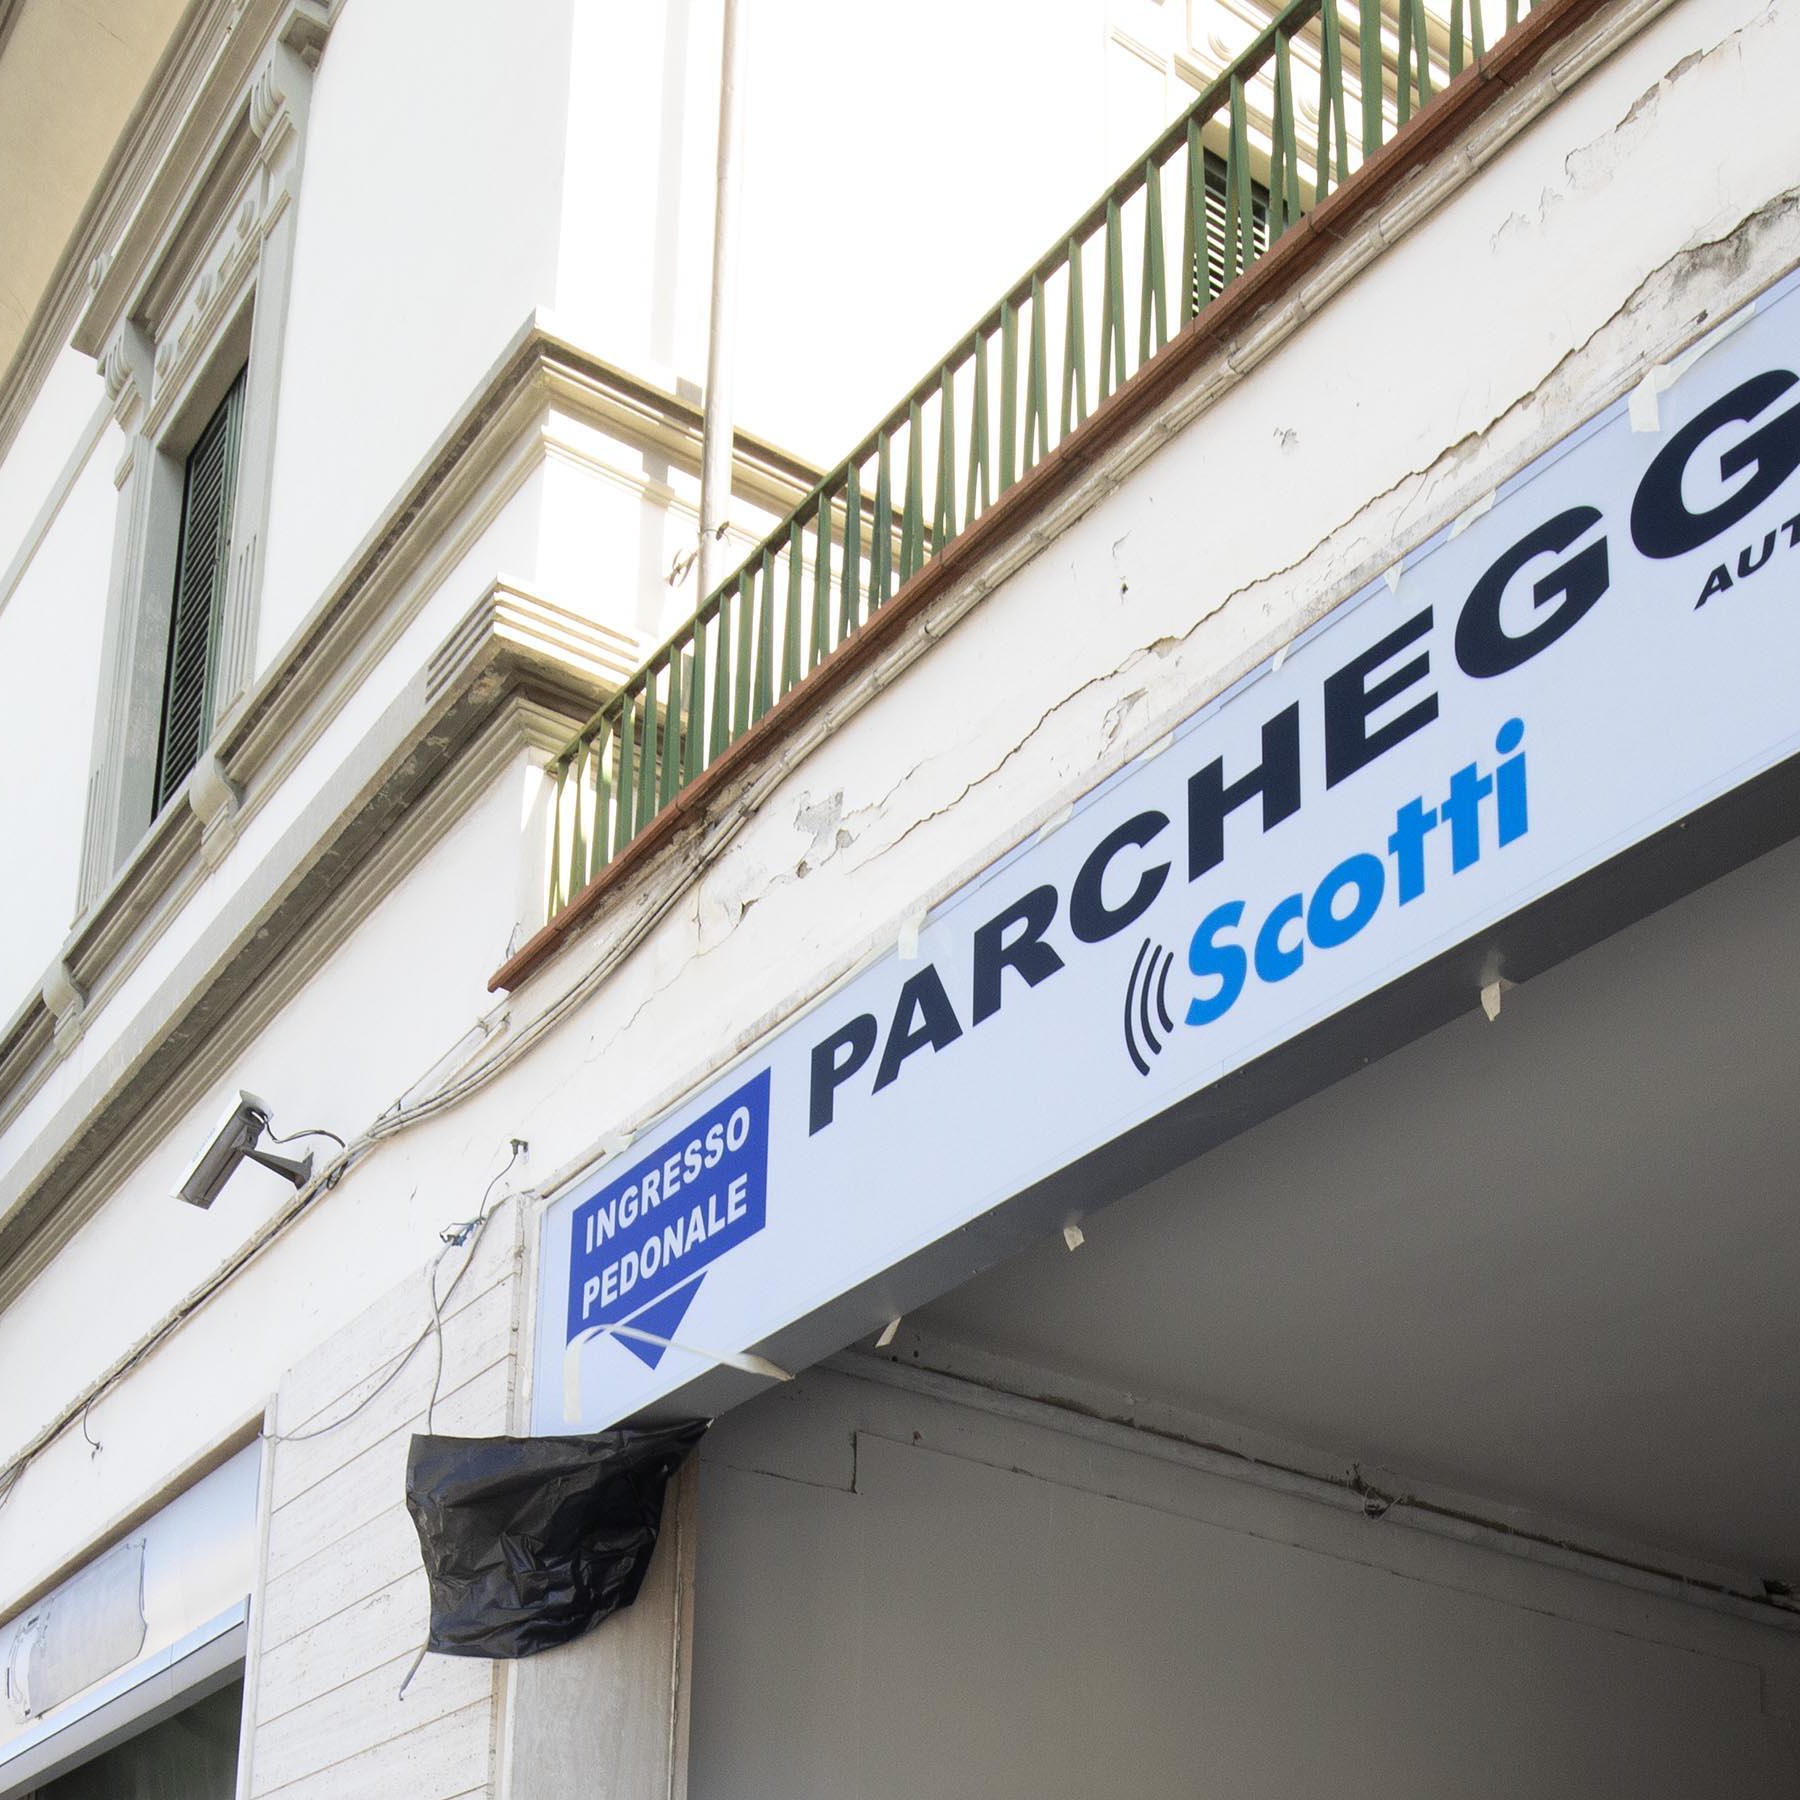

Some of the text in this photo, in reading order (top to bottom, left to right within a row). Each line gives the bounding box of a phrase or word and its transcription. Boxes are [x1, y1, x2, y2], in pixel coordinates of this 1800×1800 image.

[1185, 717, 1529, 1027] Scotti
[582, 1173, 748, 1321] PEDONALE
[585, 1105, 751, 1256] INGRESSO
